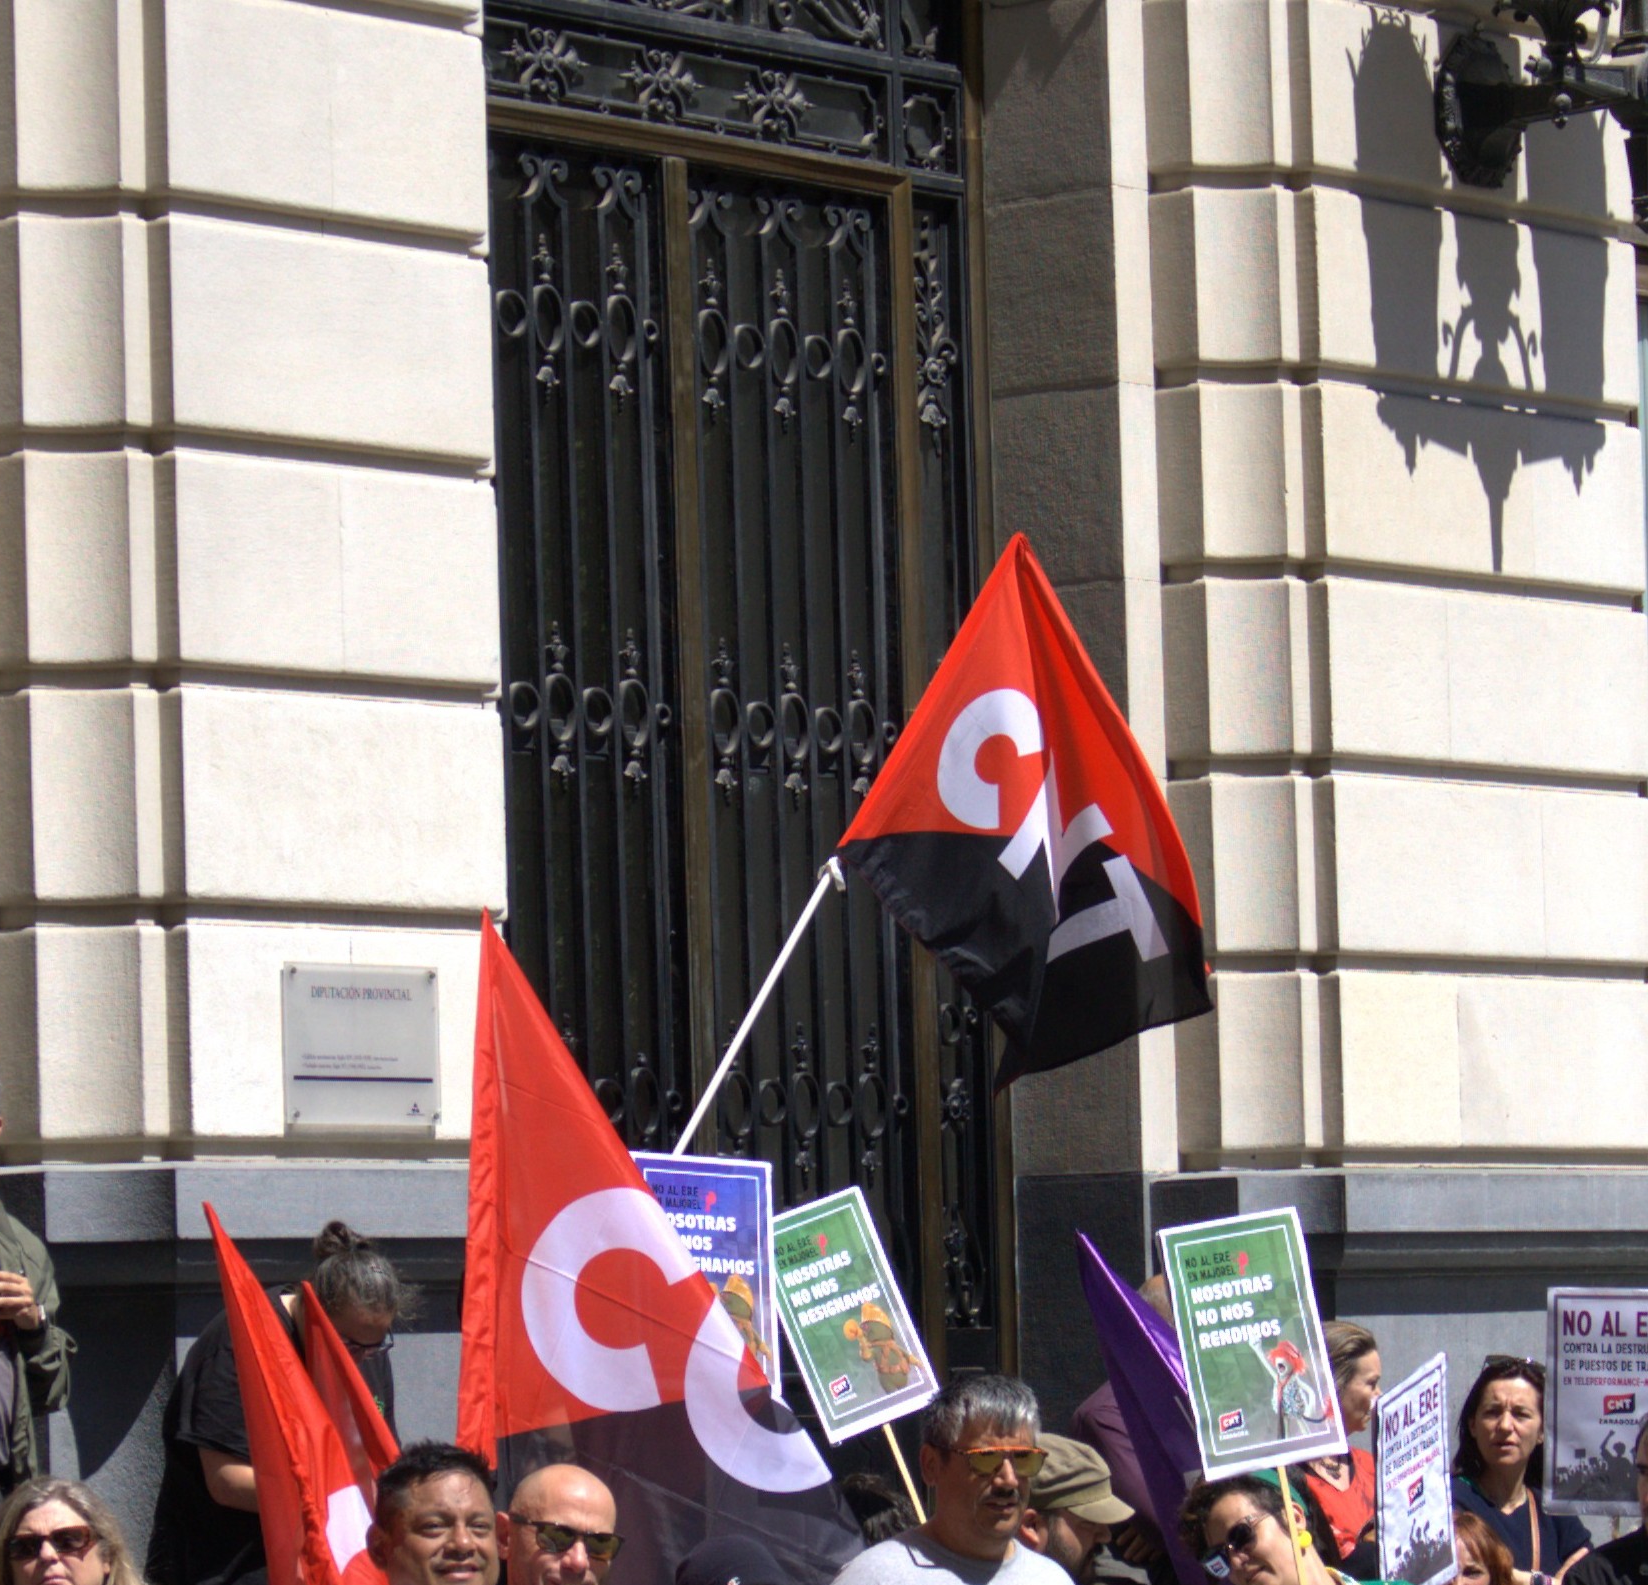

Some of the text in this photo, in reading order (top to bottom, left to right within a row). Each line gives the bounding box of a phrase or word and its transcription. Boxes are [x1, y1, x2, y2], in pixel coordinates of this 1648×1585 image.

[310, 984, 413, 1002] DIPUTACIÓN PROVINCIAL
[666, 1212, 736, 1232] OSOTRAS
[782, 1249, 852, 1288] NOSOTRAS
[1185, 1256, 1201, 1269] NO
[1213, 1250, 1231, 1264] ERE
[1187, 1264, 1236, 1283] EN MAJOREL
[790, 1277, 840, 1308] NO NOS
[1190, 1274, 1273, 1304] NOSOTRAS
[796, 1283, 881, 1328] RESIGNAMOS
[1195, 1301, 1254, 1326] NO NOS
[1198, 1318, 1282, 1350] RENDIMOS
[1563, 1310, 1592, 1337] NO
[1601, 1311, 1627, 1338] AL
[1563, 1342, 1598, 1354] CONTRA
[1601, 1343, 1612, 1354] LA
[1564, 1359, 1576, 1371] DE
[1579, 1360, 1618, 1372] PUESTOS
[1621, 1360, 1633, 1372] DE
[1563, 1375, 1572, 1386] EN
[1384, 1382, 1439, 1443] NO AL ERE
